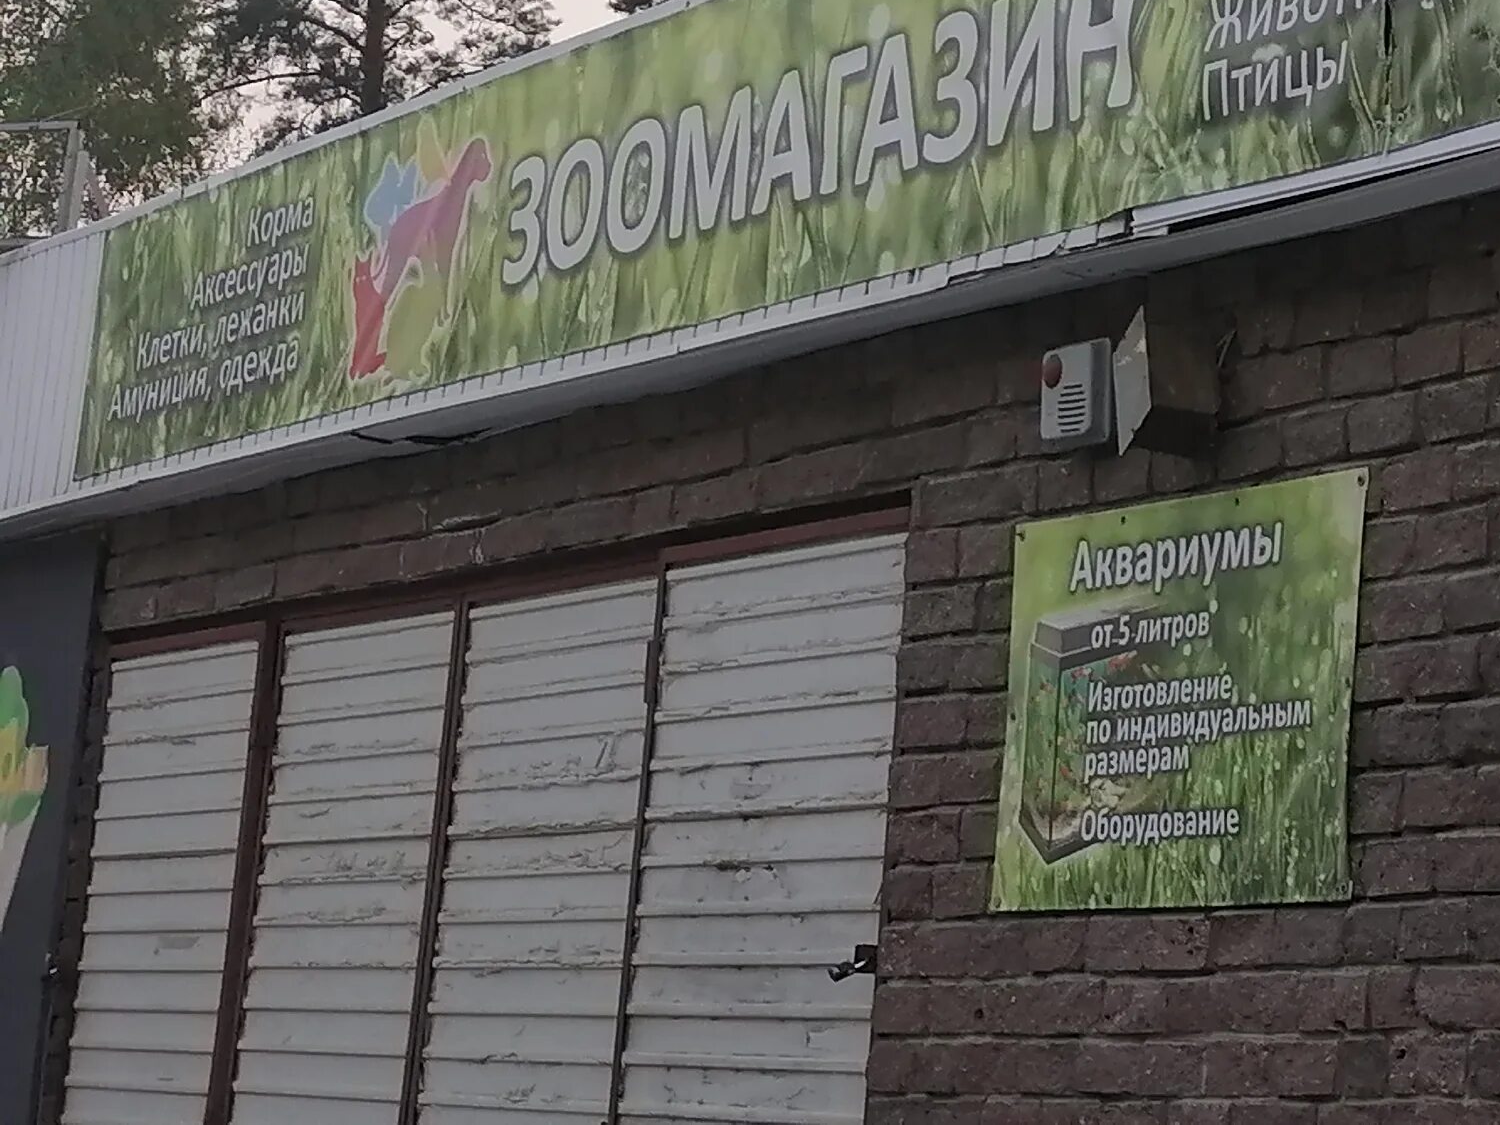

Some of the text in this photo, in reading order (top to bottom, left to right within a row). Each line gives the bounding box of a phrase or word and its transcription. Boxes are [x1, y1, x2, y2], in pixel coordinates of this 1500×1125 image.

[1201, 40, 1349, 121] Птицы
[247, 196, 314, 248] Корма
[190, 243, 310, 311] Аксессуары
[136, 291, 305, 372] Клетки, лежанки
[107, 339, 300, 423] Амуниция, одежда
[1069, 521, 1283, 594] Аквариумы
[1090, 611, 1210, 650] от 5 литров
[1085, 700, 1312, 747] по индивидуальным
[1083, 744, 1191, 783] размерам
[1080, 806, 1240, 845] Оборудование
